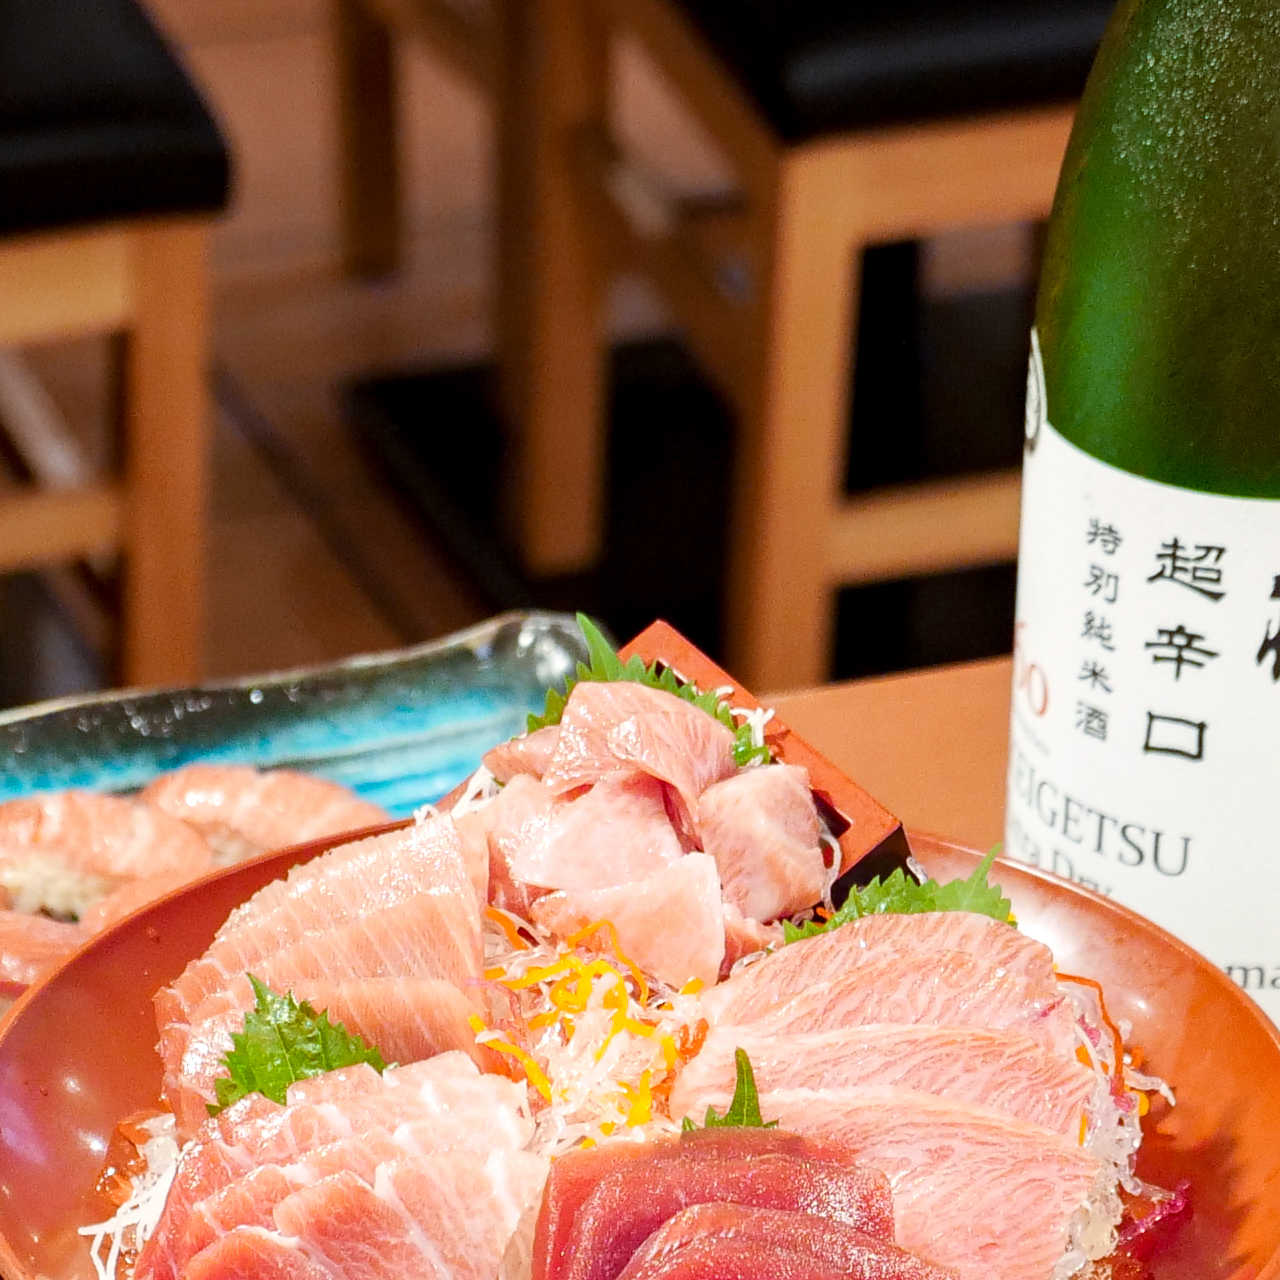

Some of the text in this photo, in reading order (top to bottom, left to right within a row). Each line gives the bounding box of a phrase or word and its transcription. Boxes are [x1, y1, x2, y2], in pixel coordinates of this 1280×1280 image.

[1076, 518, 1122, 742] 特別純米酒
[1143, 537, 1226, 762] 超辛口
